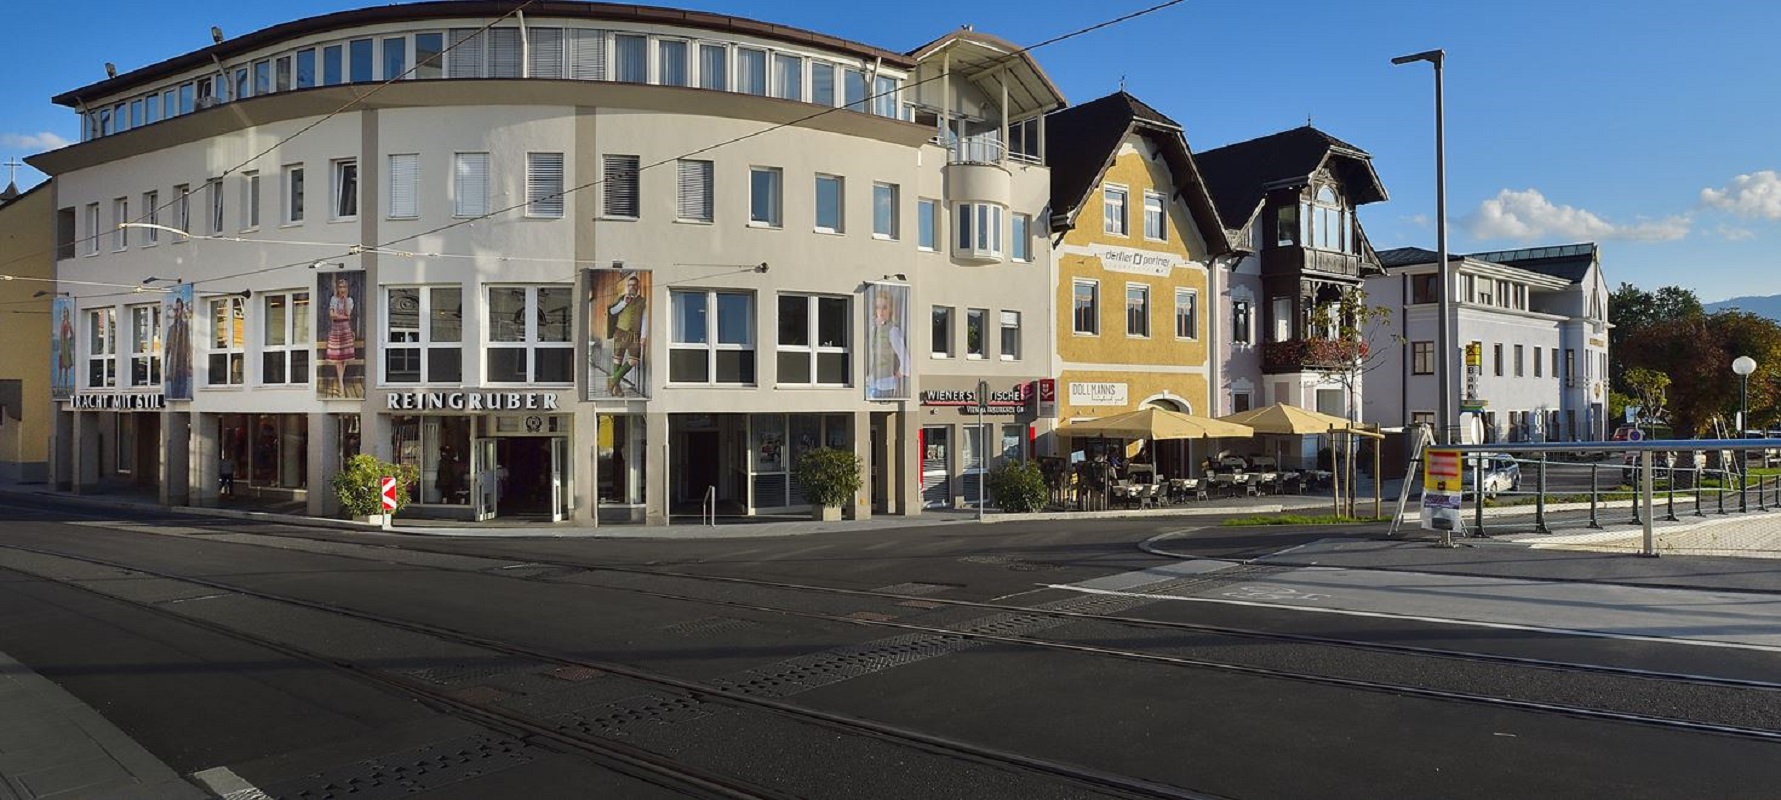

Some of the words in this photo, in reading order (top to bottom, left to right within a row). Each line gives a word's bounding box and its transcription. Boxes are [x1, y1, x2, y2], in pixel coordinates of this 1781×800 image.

[70, 394, 108, 408] TRACHT
[113, 394, 132, 408] MIT
[137, 394, 161, 408] STIL
[387, 392, 558, 410] REINGRUBER
[927, 390, 965, 401] WIENER
